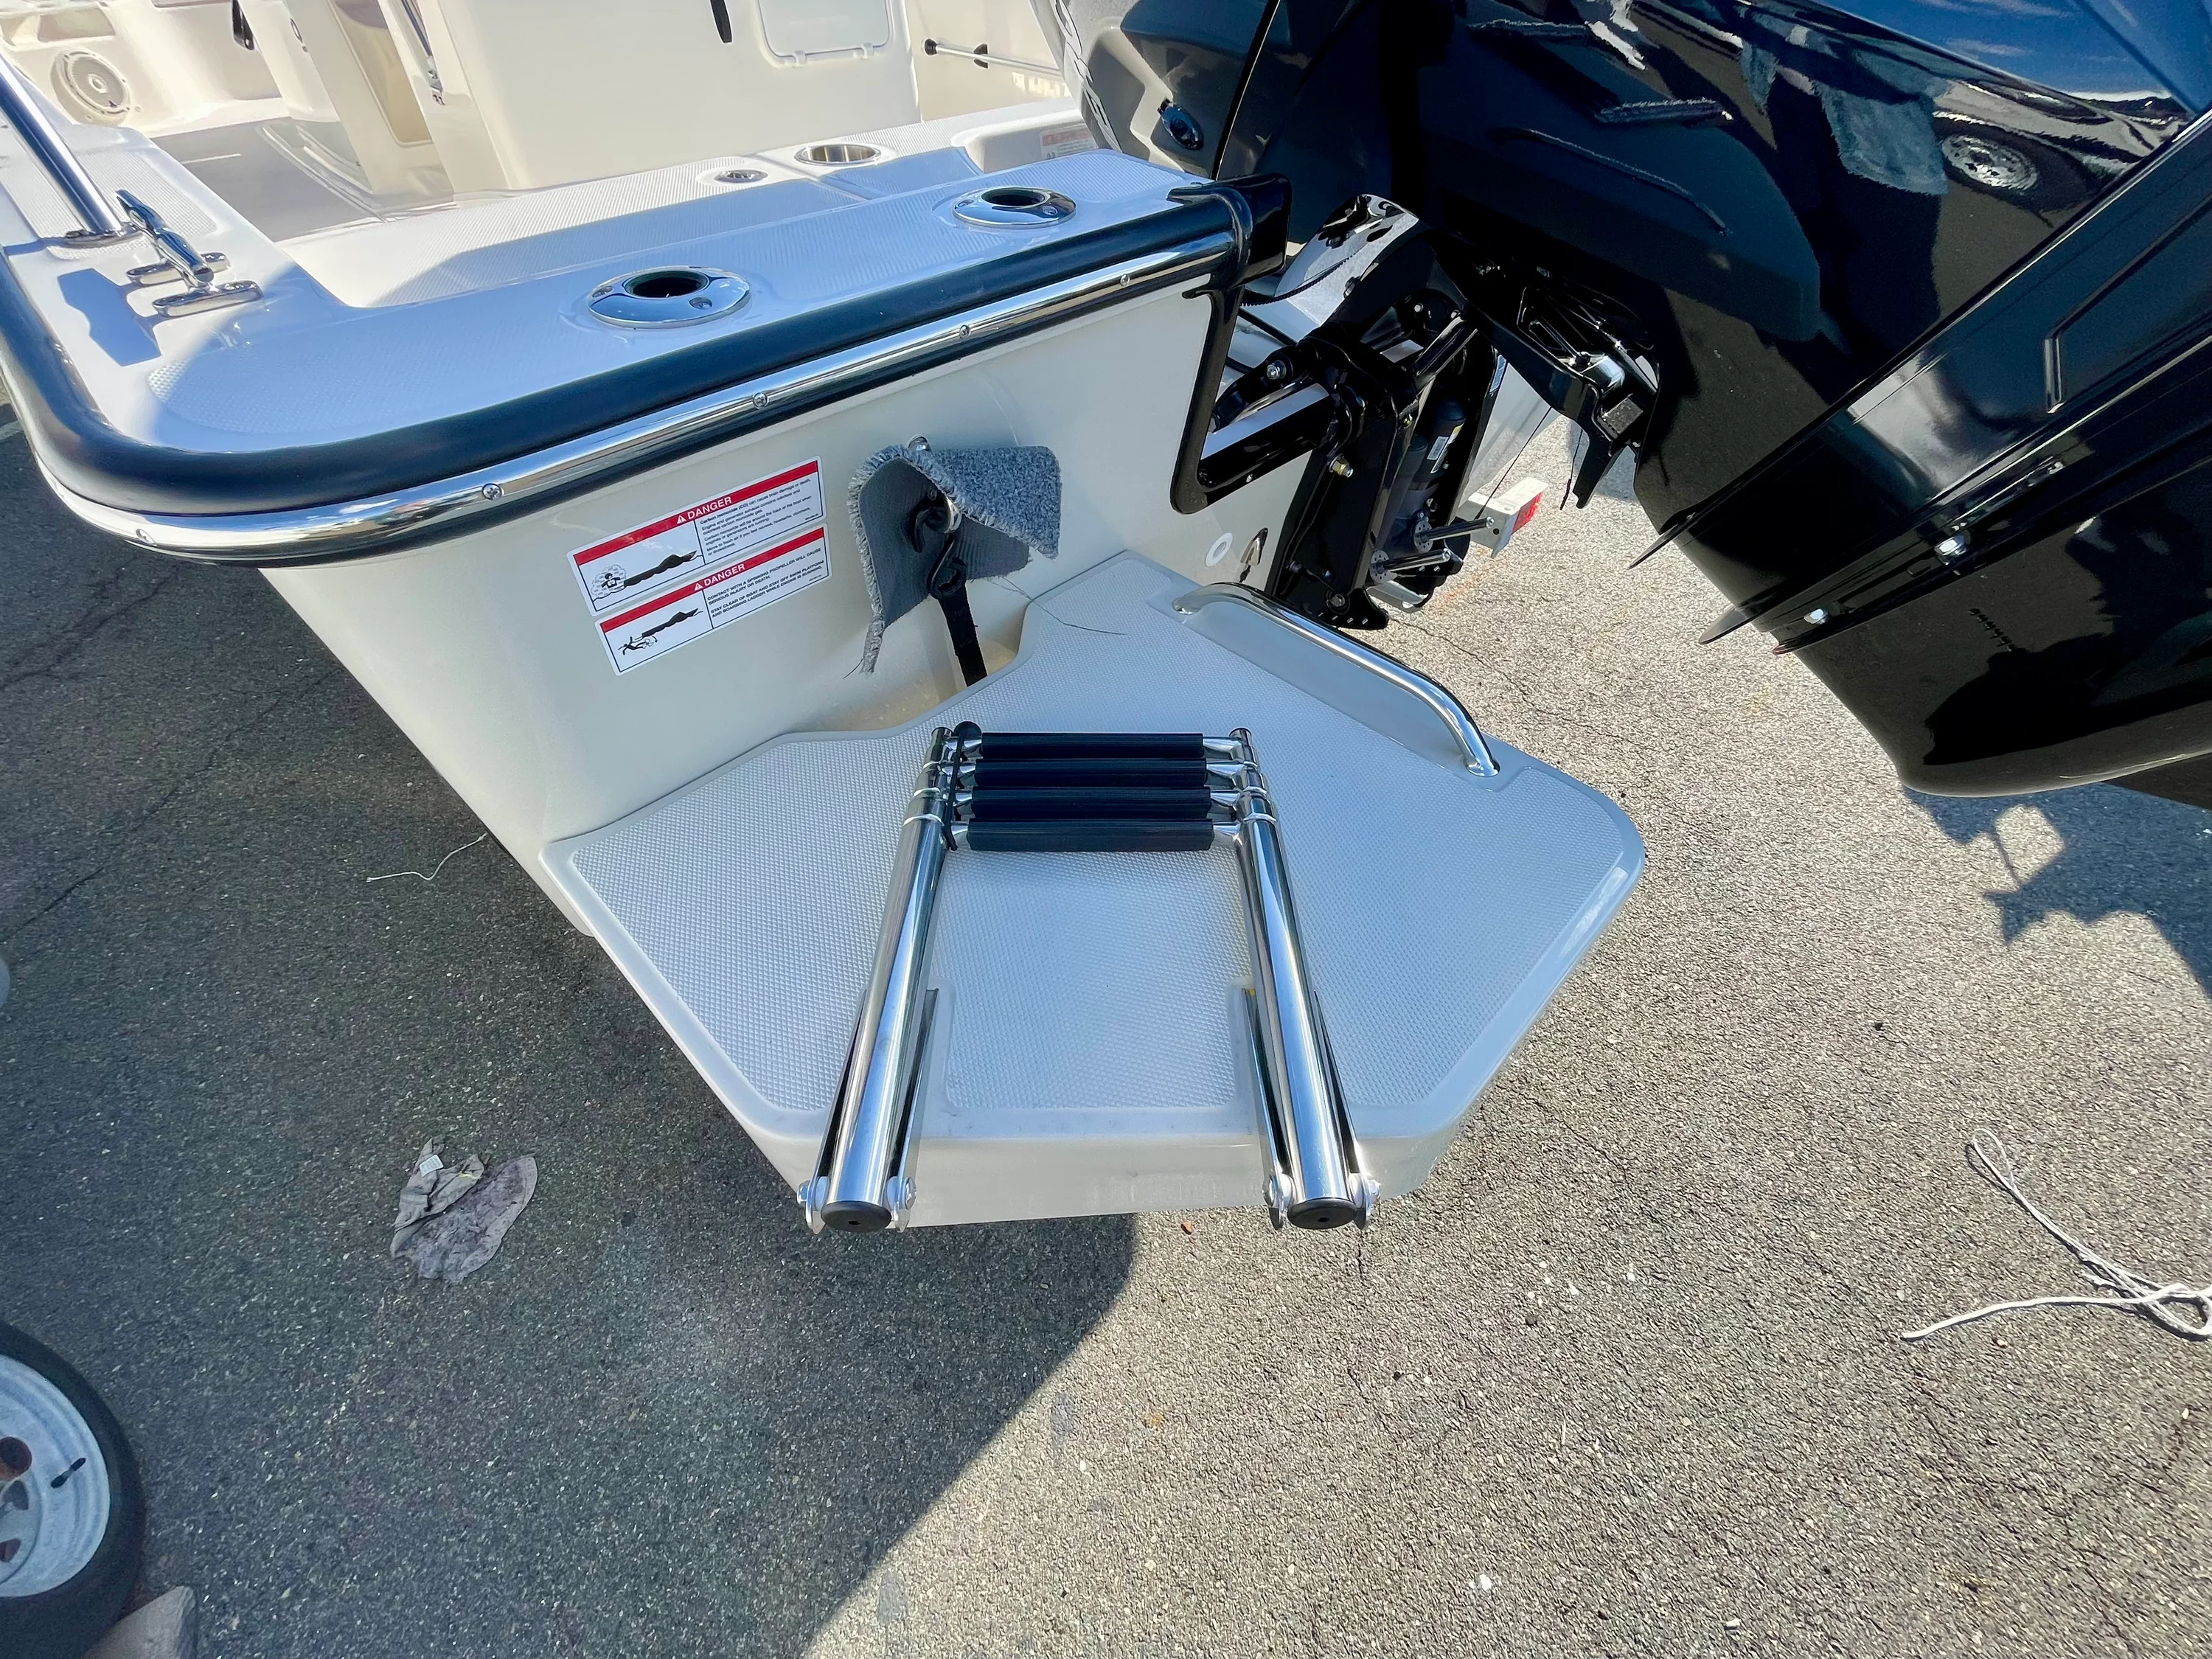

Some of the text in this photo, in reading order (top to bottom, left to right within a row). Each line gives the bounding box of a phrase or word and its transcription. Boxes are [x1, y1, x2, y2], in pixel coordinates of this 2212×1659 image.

[687, 496, 732, 520] DANGER
[704, 563, 745, 585] DANGER
[707, 588, 729, 600] CONTACT
[730, 582, 742, 591] WITH
[747, 571, 768, 583] SPINNING
[769, 559, 795, 573] PROPELLER
[708, 593, 728, 605] SERIOUS
[729, 585, 746, 595] INJURY
[710, 605, 722, 613] STAY
[723, 598, 738, 608] CLEAR
[745, 589, 757, 597] BOAT
[801, 560, 824, 572] PLATFORM
[723, 599, 747, 613] BOARDING
[747, 591, 765, 601] LADDER
